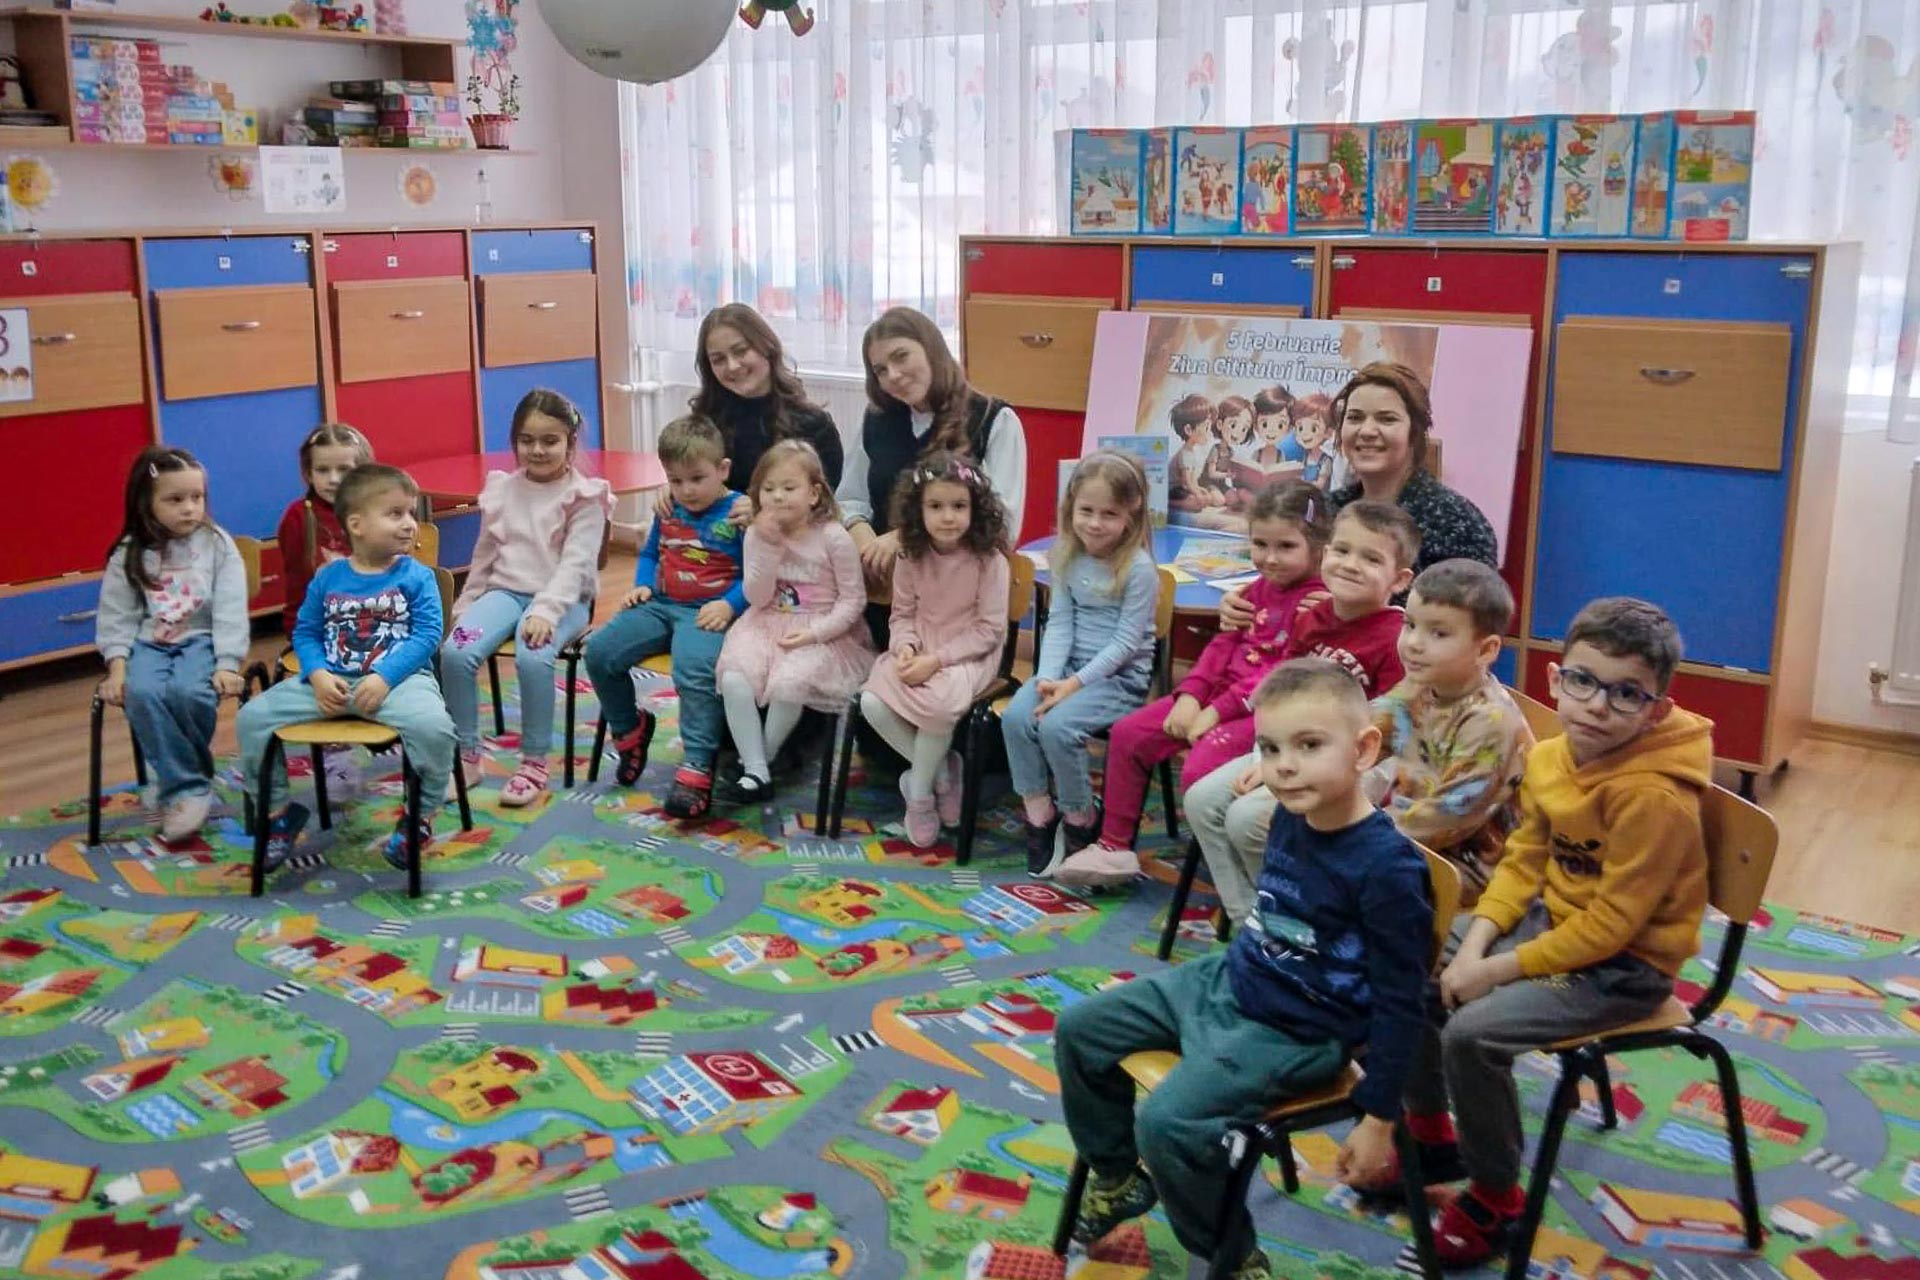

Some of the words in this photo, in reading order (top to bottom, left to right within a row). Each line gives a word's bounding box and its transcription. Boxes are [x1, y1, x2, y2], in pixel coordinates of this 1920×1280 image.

[1227, 331, 1241, 350] 5
[1243, 331, 1342, 354] Februarie
[1168, 354, 1208, 375] Ziua
[1213, 357, 1293, 380] Cititului
